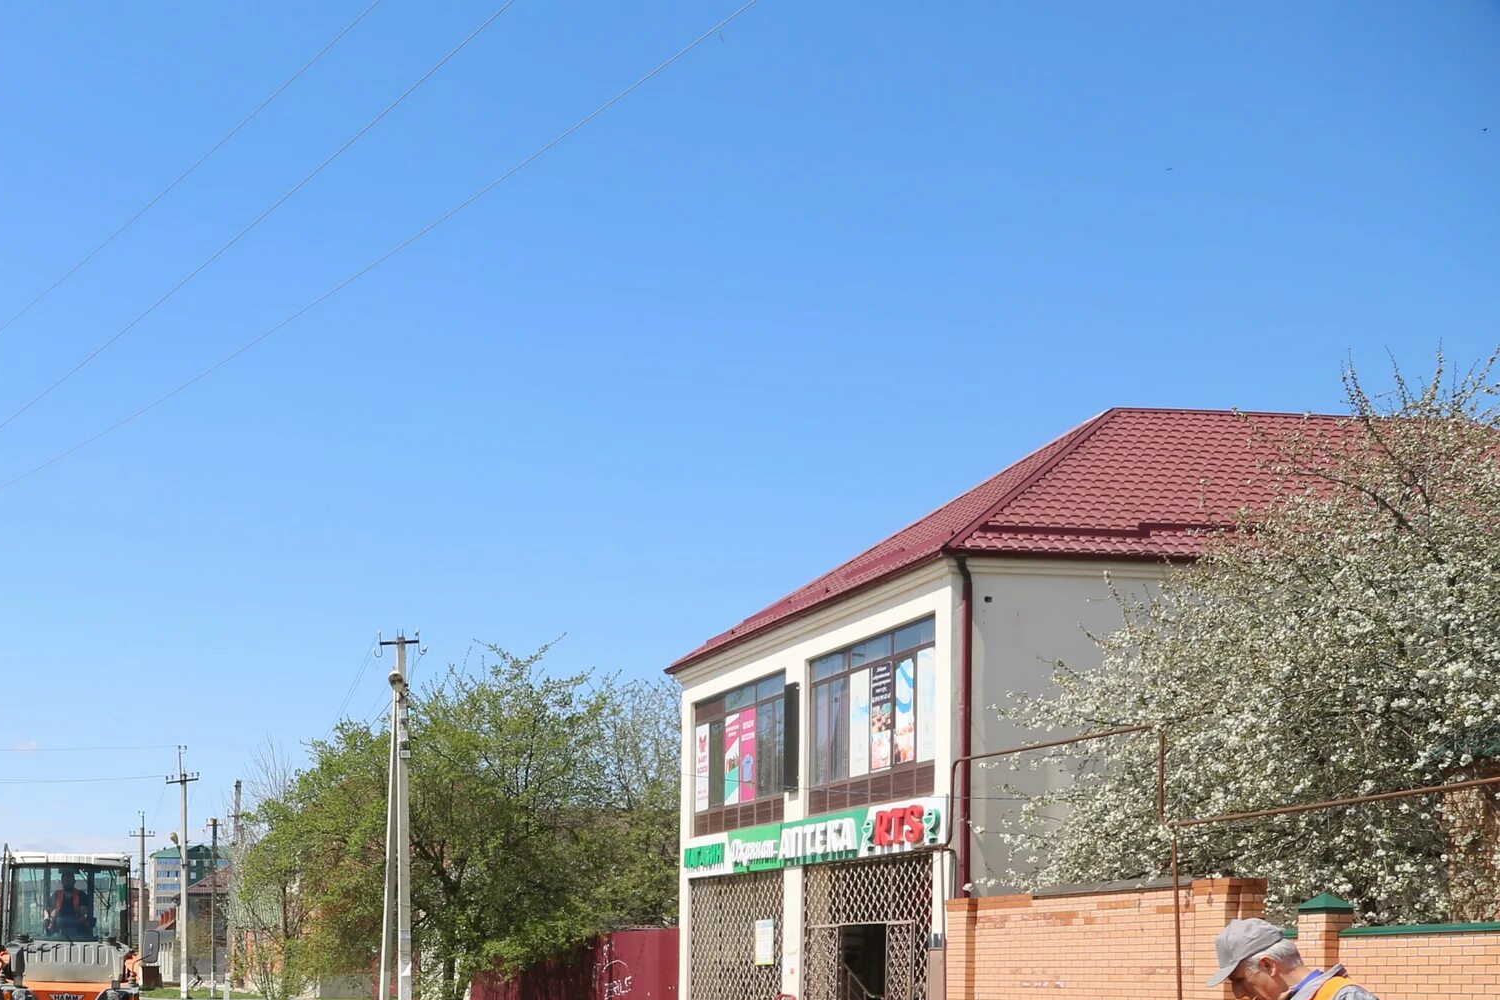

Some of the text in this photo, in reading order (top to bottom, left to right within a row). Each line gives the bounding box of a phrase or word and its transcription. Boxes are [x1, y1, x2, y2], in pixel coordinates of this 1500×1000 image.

[684, 842, 726, 869] МАГАЗИН
[779, 817, 858, 860] АПТЕКА
[874, 804, 925, 847] RTS
